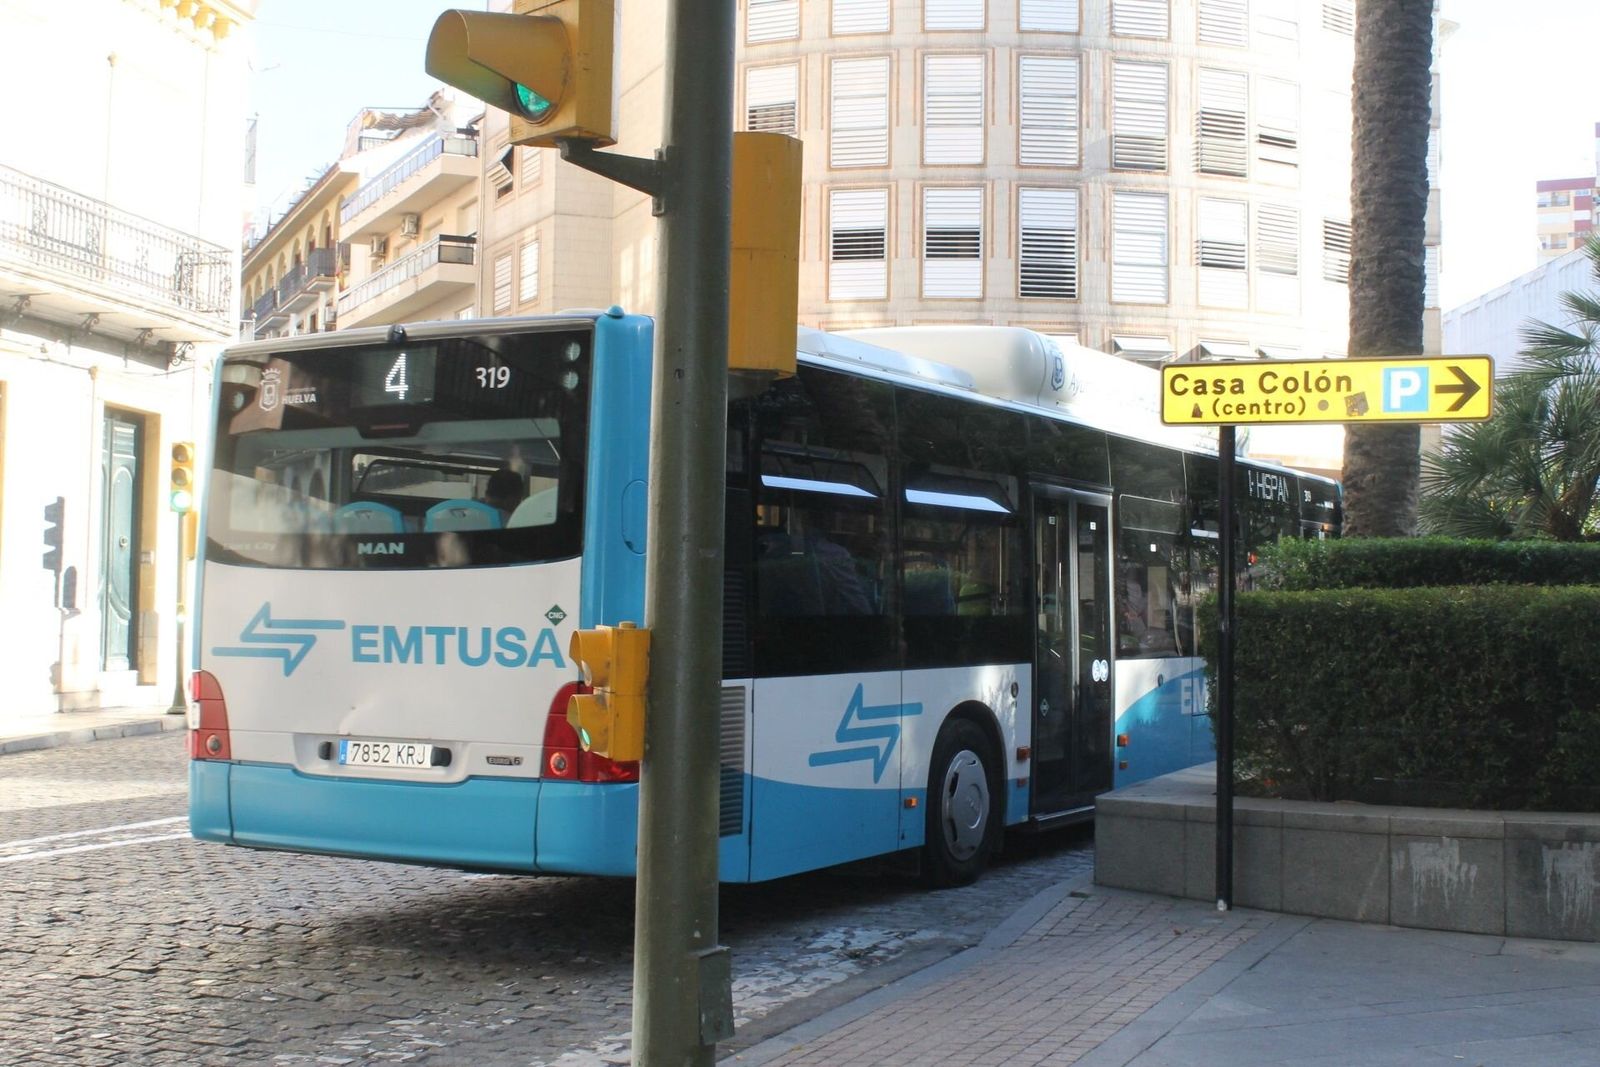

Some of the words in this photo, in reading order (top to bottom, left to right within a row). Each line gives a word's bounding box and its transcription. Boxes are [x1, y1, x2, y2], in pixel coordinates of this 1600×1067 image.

[385, 353, 409, 400] 4
[476, 366, 510, 389] 319
[1169, 373, 1245, 396] Casa
[1258, 368, 1352, 395] Colón
[282, 393, 317, 405] HUELVA
[1391, 370, 1421, 410] P
[1212, 396, 1306, 418] (centro)
[358, 542, 405, 555] MAN
[548, 611, 563, 619] CNG
[351, 624, 567, 669] EMTUSA
[352, 743, 391, 763] 7852
[396, 744, 426, 765] KRJ
[513, 757, 521, 765] 6
